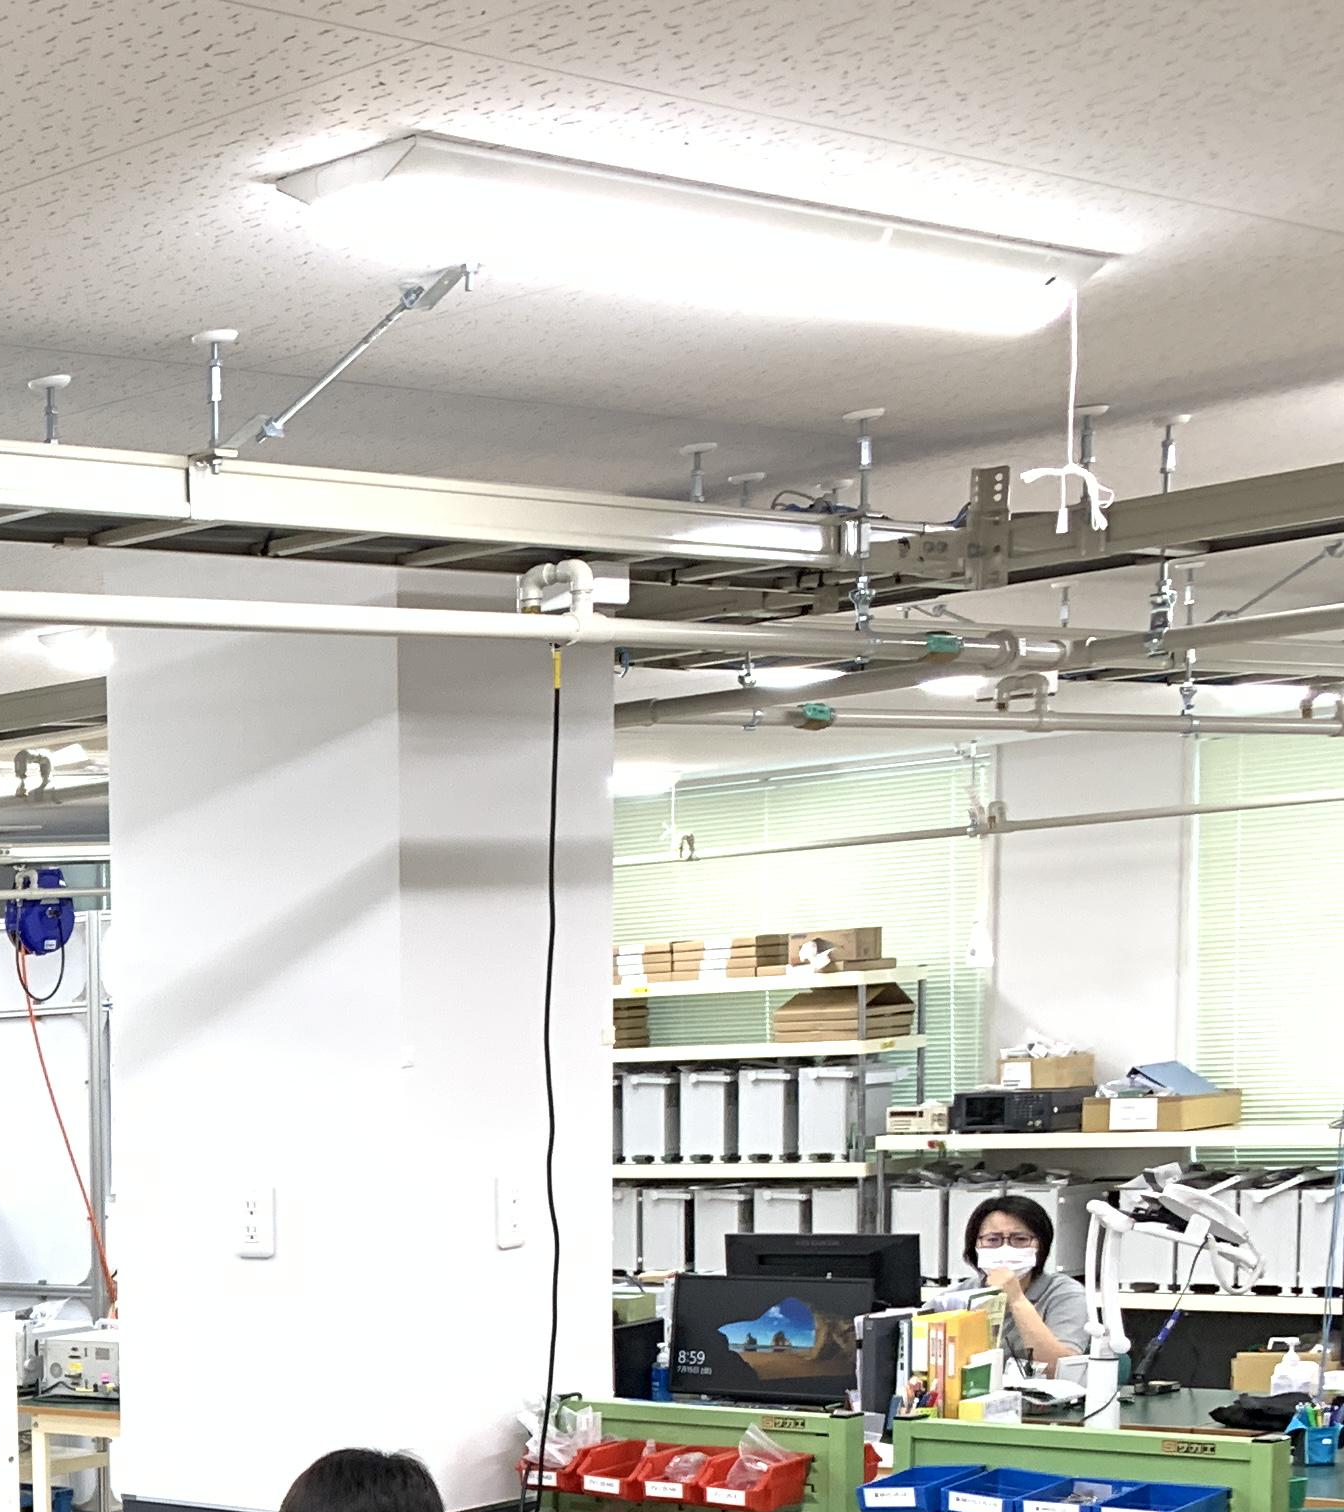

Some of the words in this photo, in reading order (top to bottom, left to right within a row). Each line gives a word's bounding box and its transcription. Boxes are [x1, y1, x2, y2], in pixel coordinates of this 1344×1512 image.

[678, 1350, 706, 1364] 8:59
[1178, 1442, 1215, 1454] サカエ
